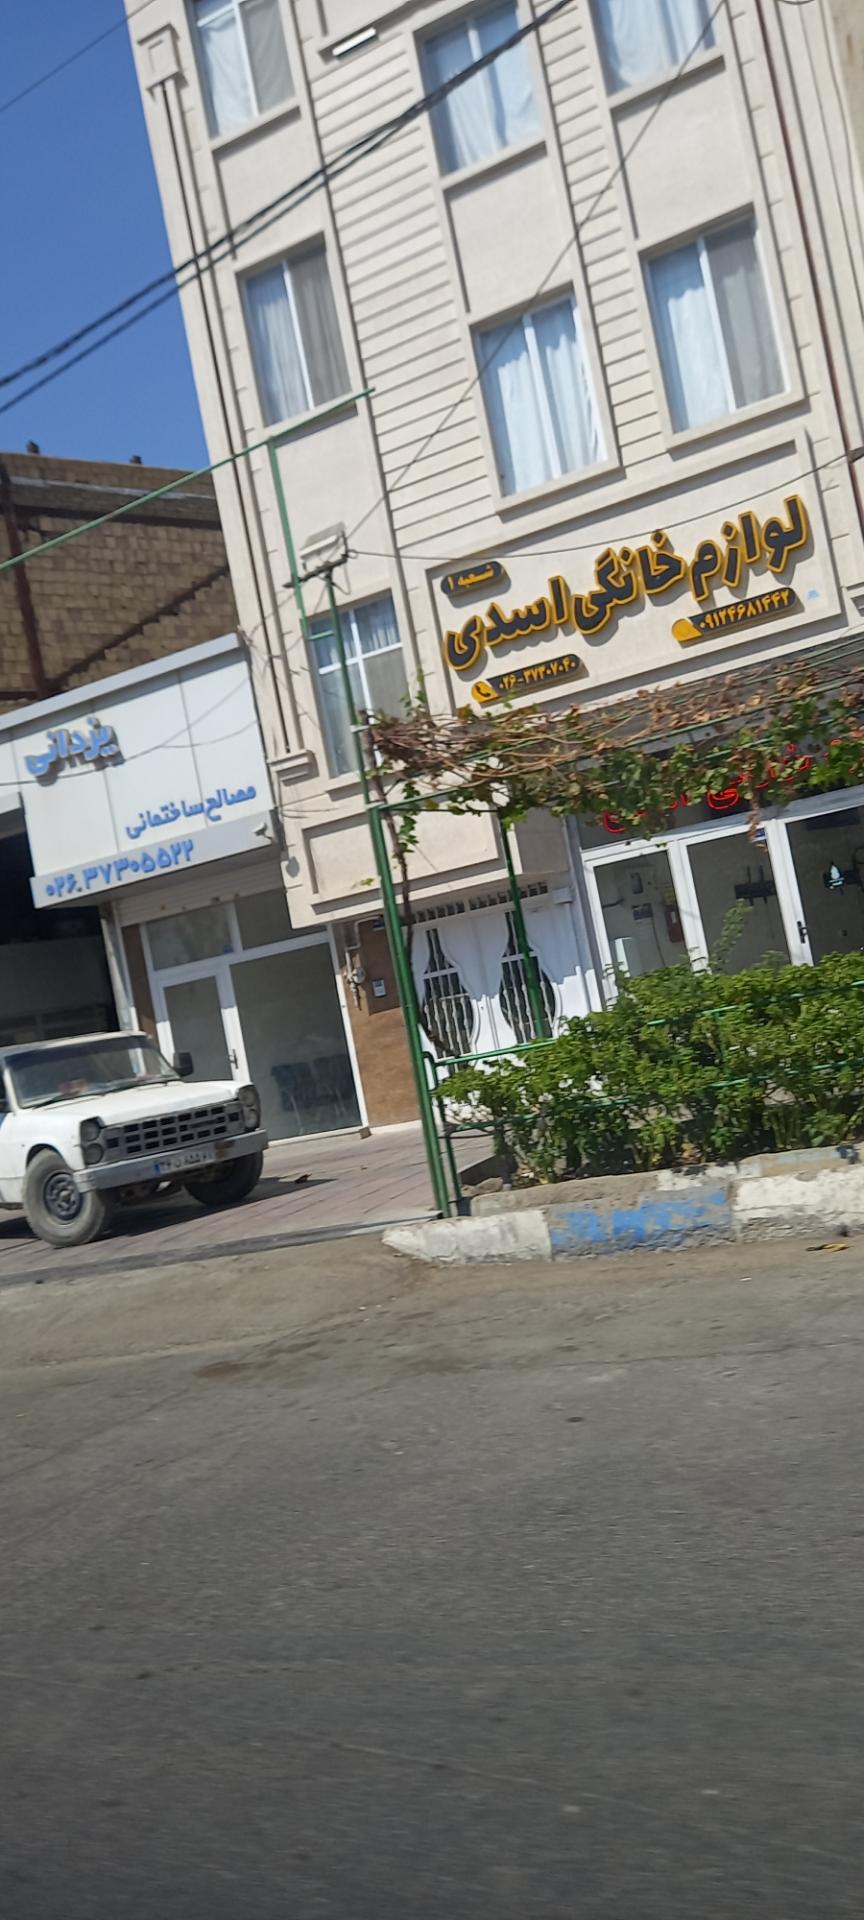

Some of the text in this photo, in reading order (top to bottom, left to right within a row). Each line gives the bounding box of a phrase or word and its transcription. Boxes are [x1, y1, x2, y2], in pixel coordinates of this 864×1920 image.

[445, 494, 808, 671] لوازم خانگی اسدی
[457, 563, 495, 589] شعبه
[24, 716, 118, 776] یزدانی
[125, 785, 257, 840] مصالح ساختمانی
[45, 839, 195, 898] ۰۲۶.۳۷۳۰۵۵۲۲
